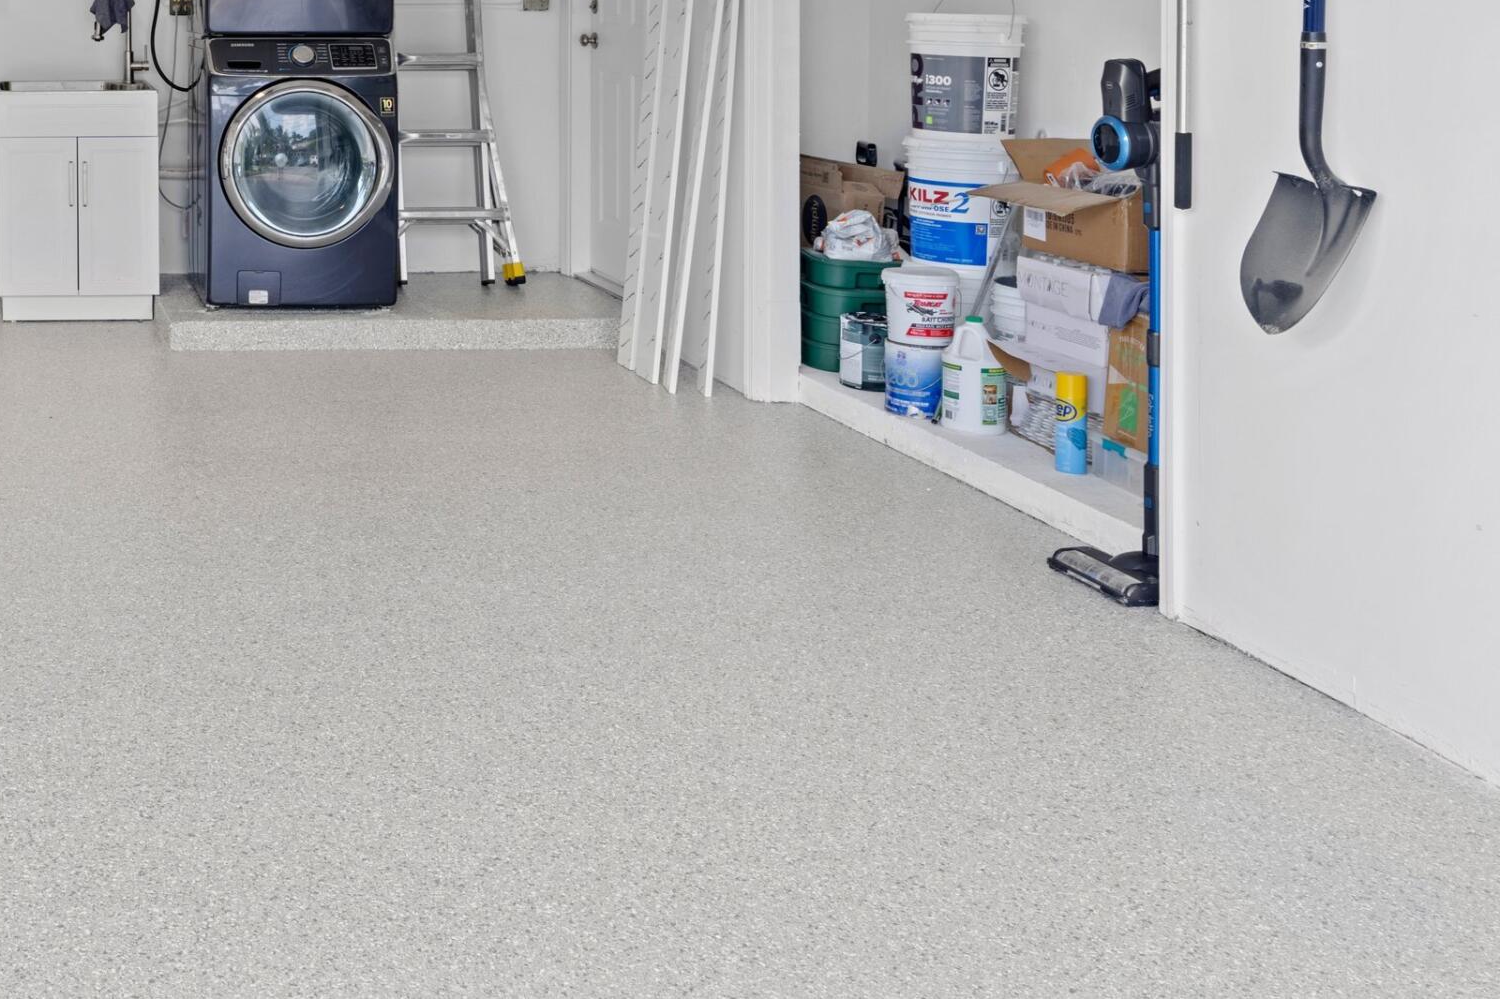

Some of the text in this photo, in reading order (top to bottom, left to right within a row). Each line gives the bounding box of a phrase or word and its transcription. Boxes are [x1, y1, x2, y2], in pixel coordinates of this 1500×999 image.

[925, 74, 952, 86] i300
[909, 186, 970, 214] KILZ 2
[1056, 404, 1072, 417] ep
